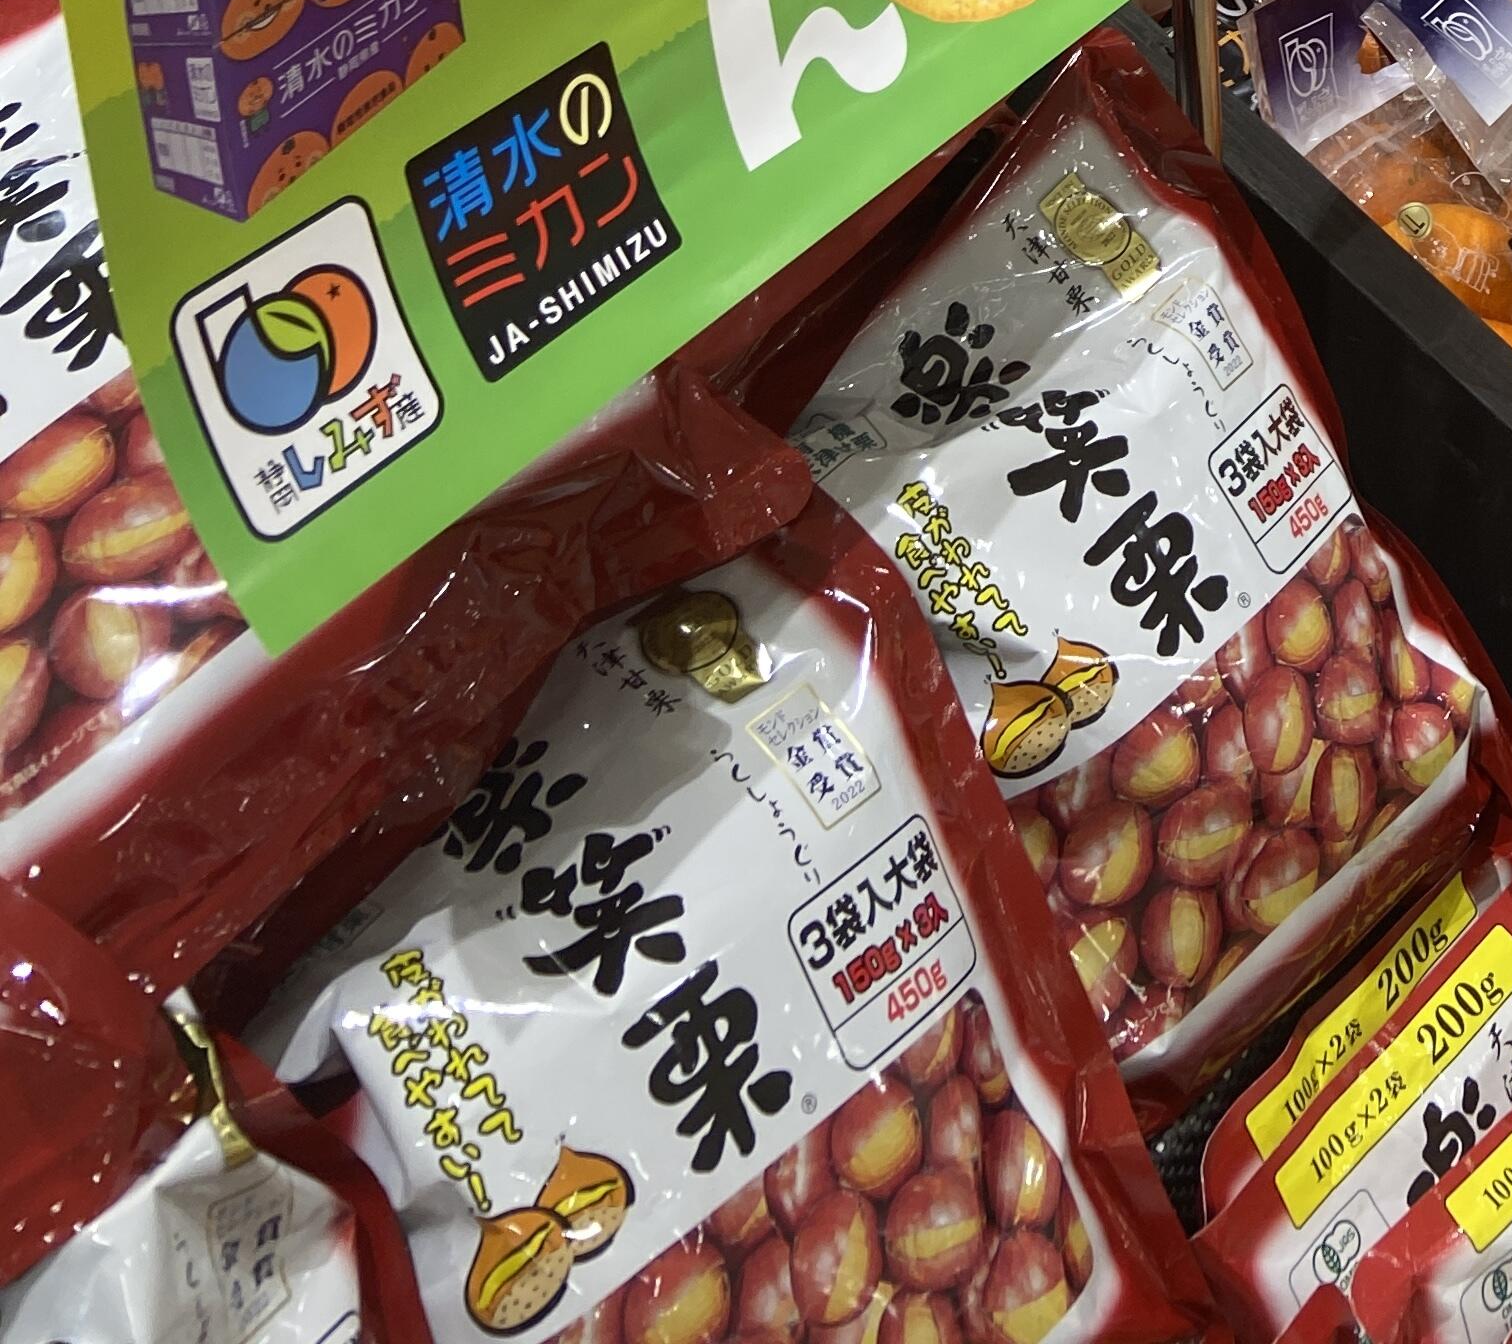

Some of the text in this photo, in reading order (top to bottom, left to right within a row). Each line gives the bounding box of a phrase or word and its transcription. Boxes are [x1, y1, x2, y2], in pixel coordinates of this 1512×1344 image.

[422, 72, 613, 243] 清水の
[446, 151, 642, 309] ミカン
[1111, 241, 1148, 283] GOLD
[1400, 214, 1425, 235] LL
[487, 218, 669, 367] JA-SHIMIZU
[1288, 493, 1329, 542] 450g
[807, 751, 865, 803] 受賞
[830, 779, 866, 811] 2022
[799, 830, 941, 971] 3袋入大袋
[885, 959, 949, 1026] 450g
[1377, 916, 1451, 1012] 200g
[1416, 971, 1504, 1064] 200g
